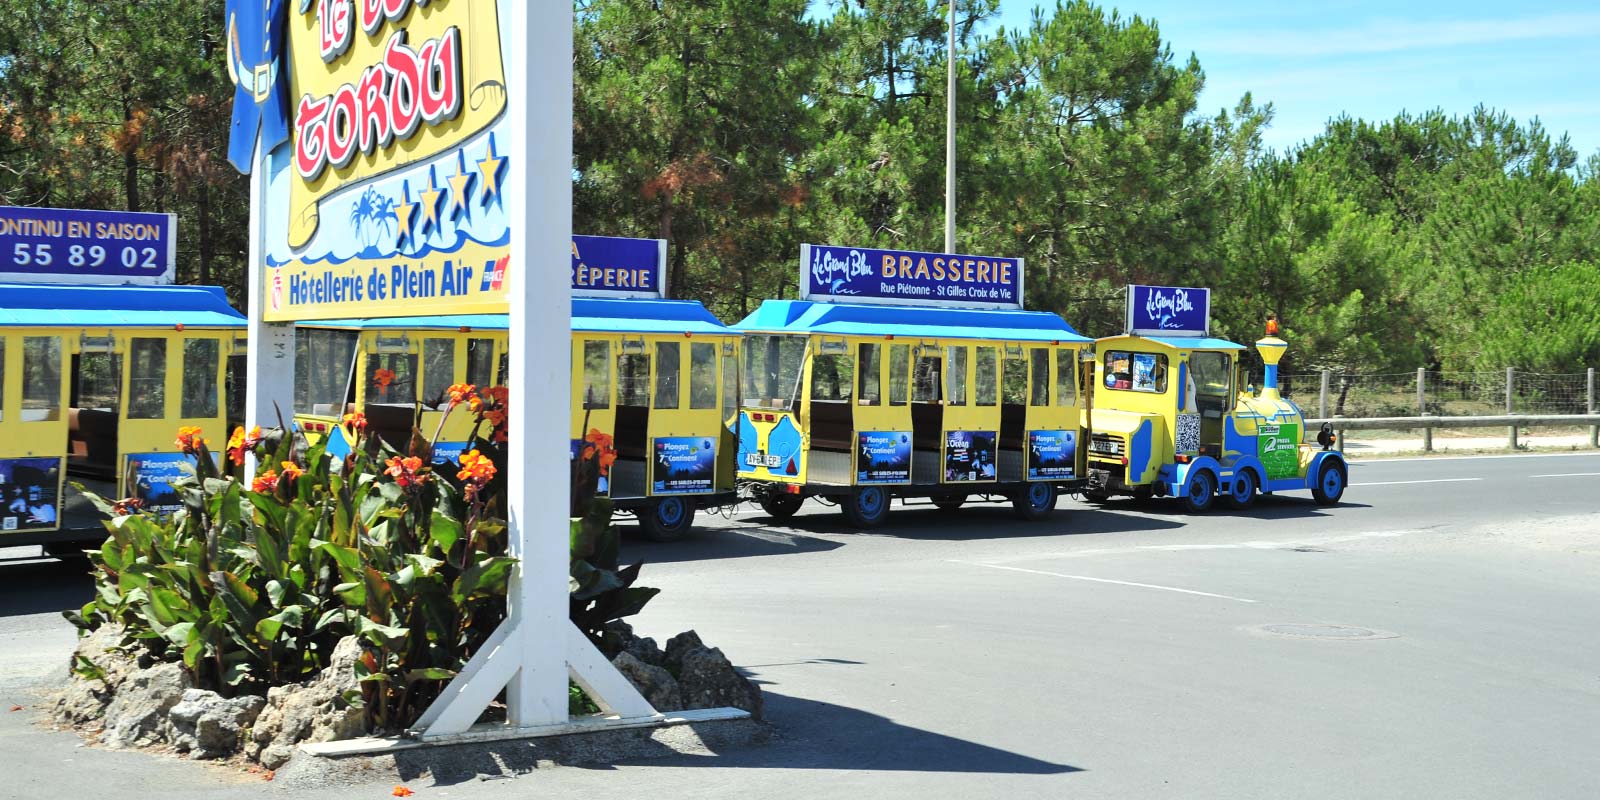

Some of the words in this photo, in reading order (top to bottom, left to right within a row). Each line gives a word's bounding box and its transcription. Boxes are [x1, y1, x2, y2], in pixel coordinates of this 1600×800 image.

[67, 221, 91, 239] EN
[95, 222, 160, 241] SAISON
[13, 243, 53, 266] 55
[68, 245, 106, 267] 89
[121, 247, 158, 269] 02
[289, 268, 364, 305] Hôtellerie
[367, 266, 387, 301] de
[391, 261, 436, 299] Plein
[440, 258, 474, 297] Air
[571, 262, 651, 288] ÊPERIE
[882, 255, 1012, 285] BRASSERIE
[880, 282, 895, 294] Rue
[897, 283, 931, 296] Piétonne
[937, 285, 946, 297] St
[946, 285, 967, 298] Gilles
[968, 287, 988, 299] Croix
[989, 288, 999, 299] de
[999, 289, 1012, 299] Vie
[434, 448, 462, 458] Plonge
